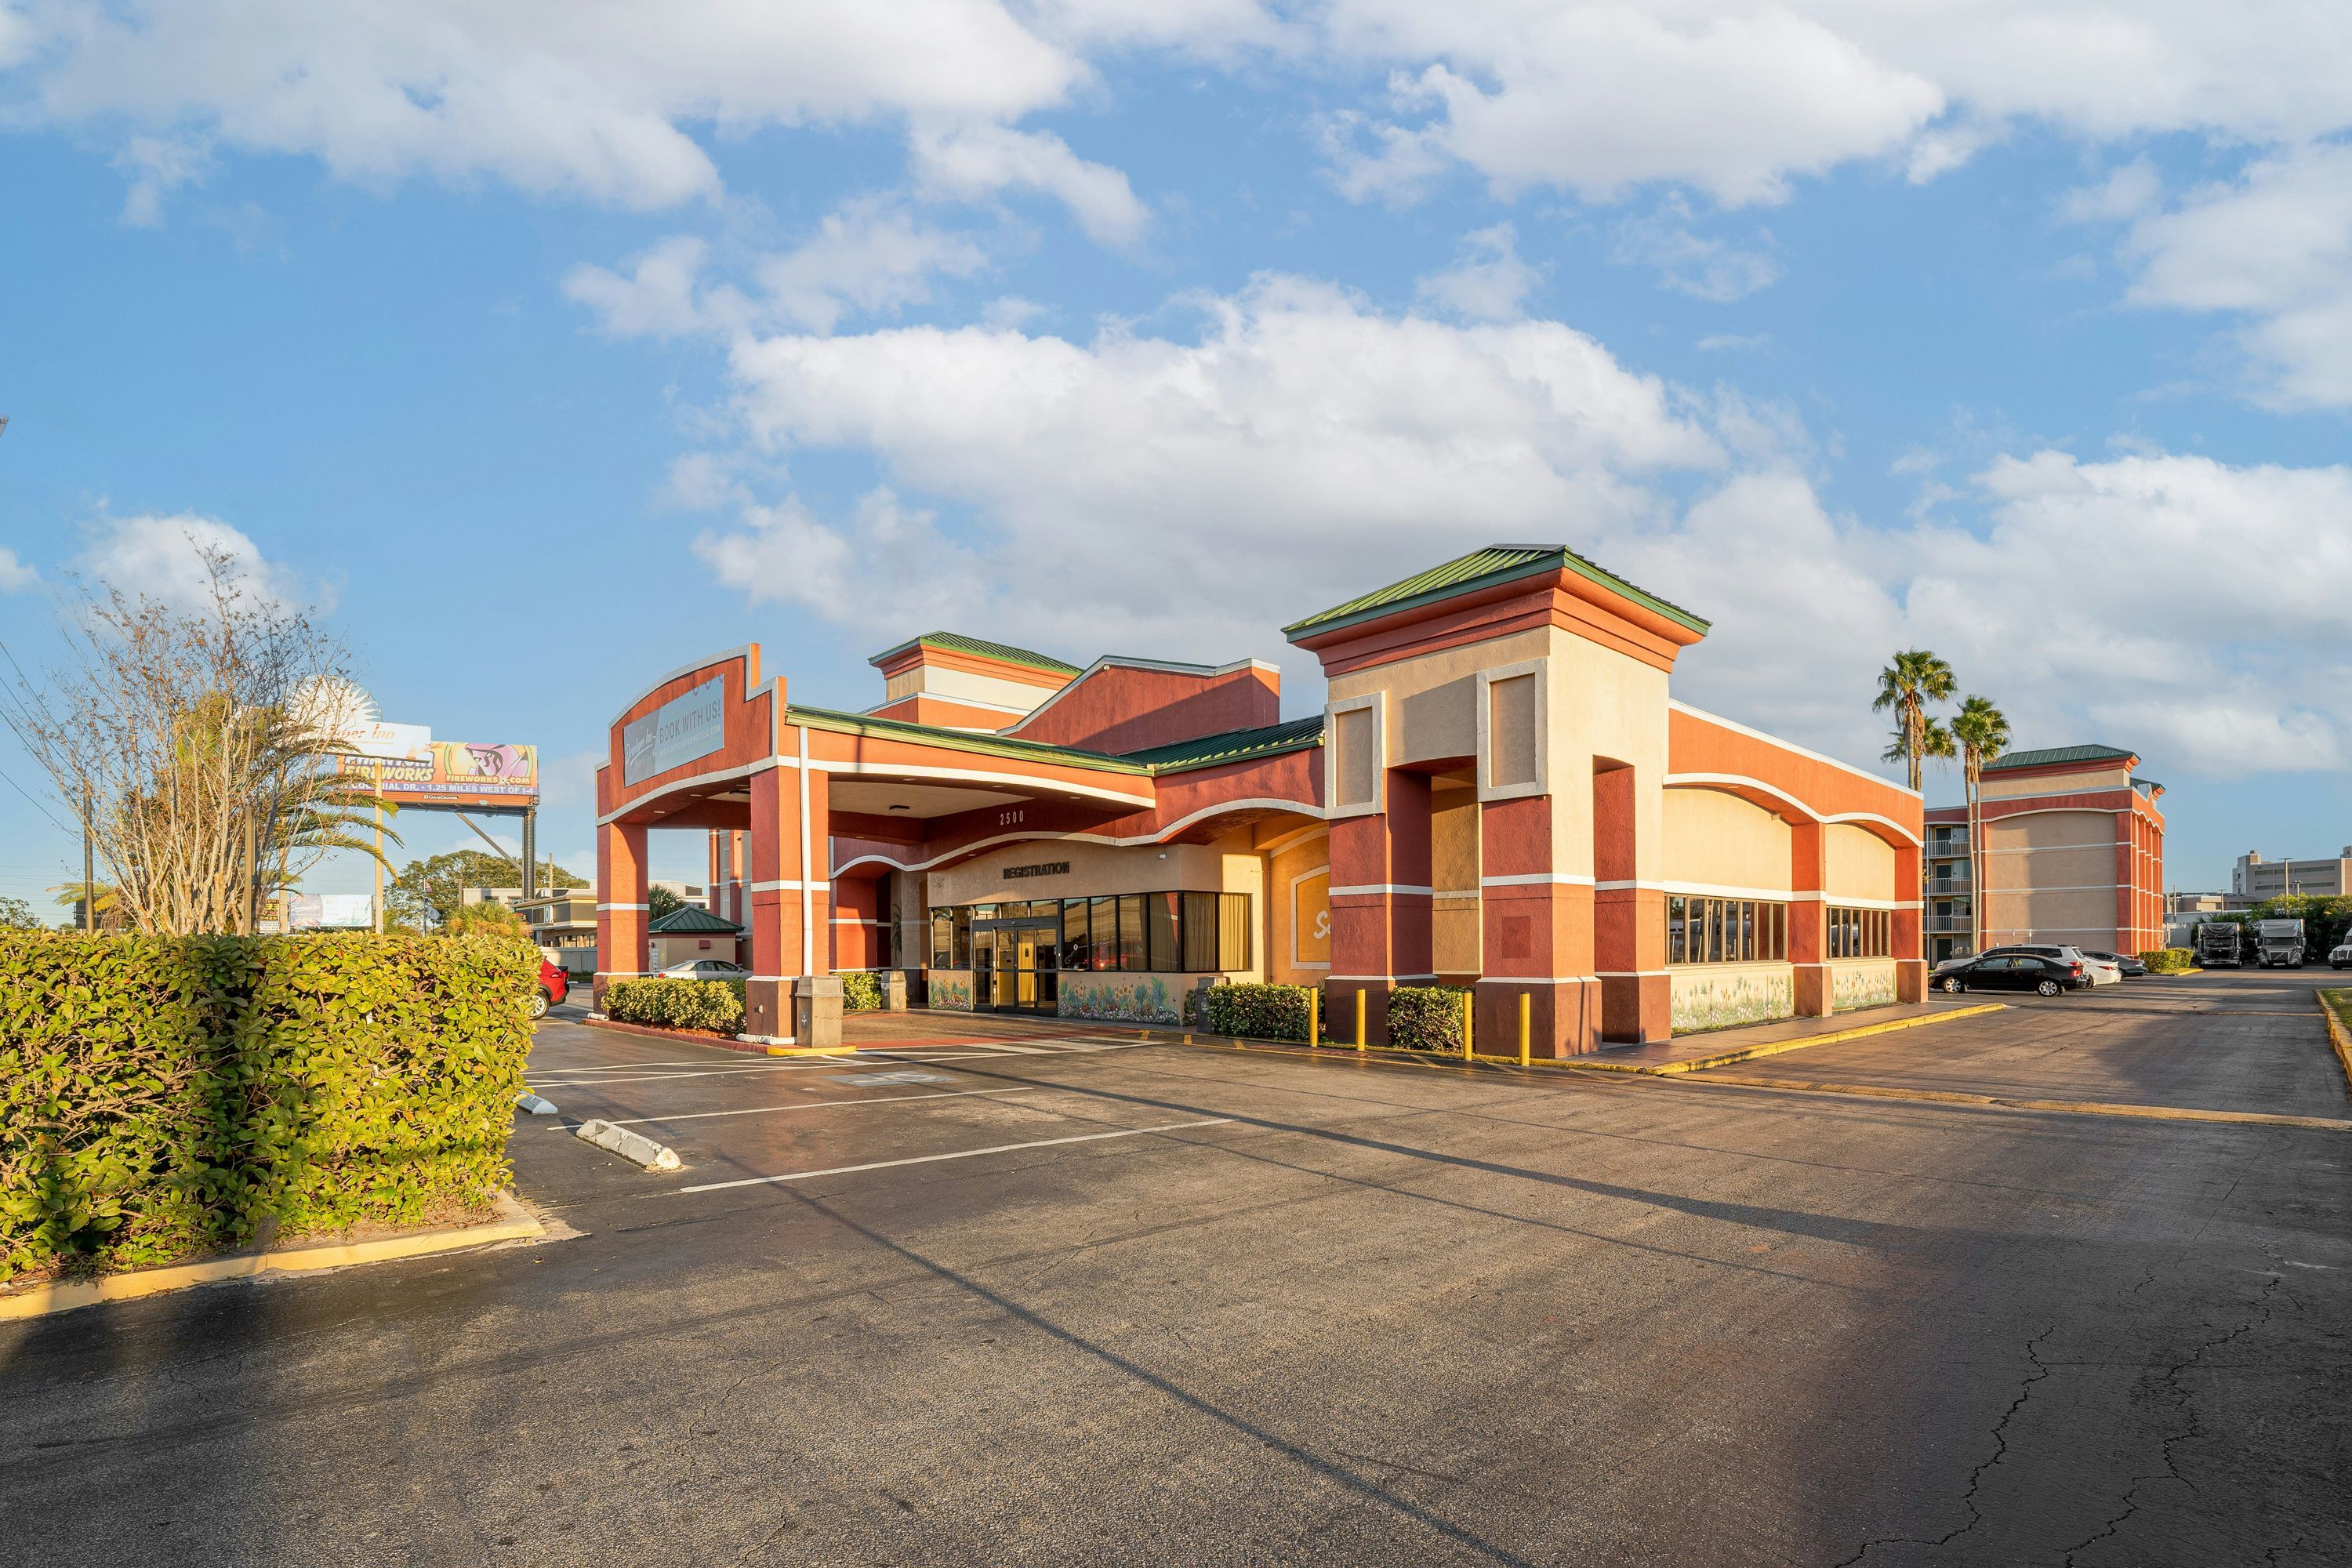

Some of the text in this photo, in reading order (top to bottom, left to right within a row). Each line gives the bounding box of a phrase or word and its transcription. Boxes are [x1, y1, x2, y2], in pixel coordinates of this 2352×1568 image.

[659, 699, 720, 744] BOOK WITH US!
[1000, 810, 1024, 826] 2500
[1004, 861, 1069, 879] REGISTRATION
